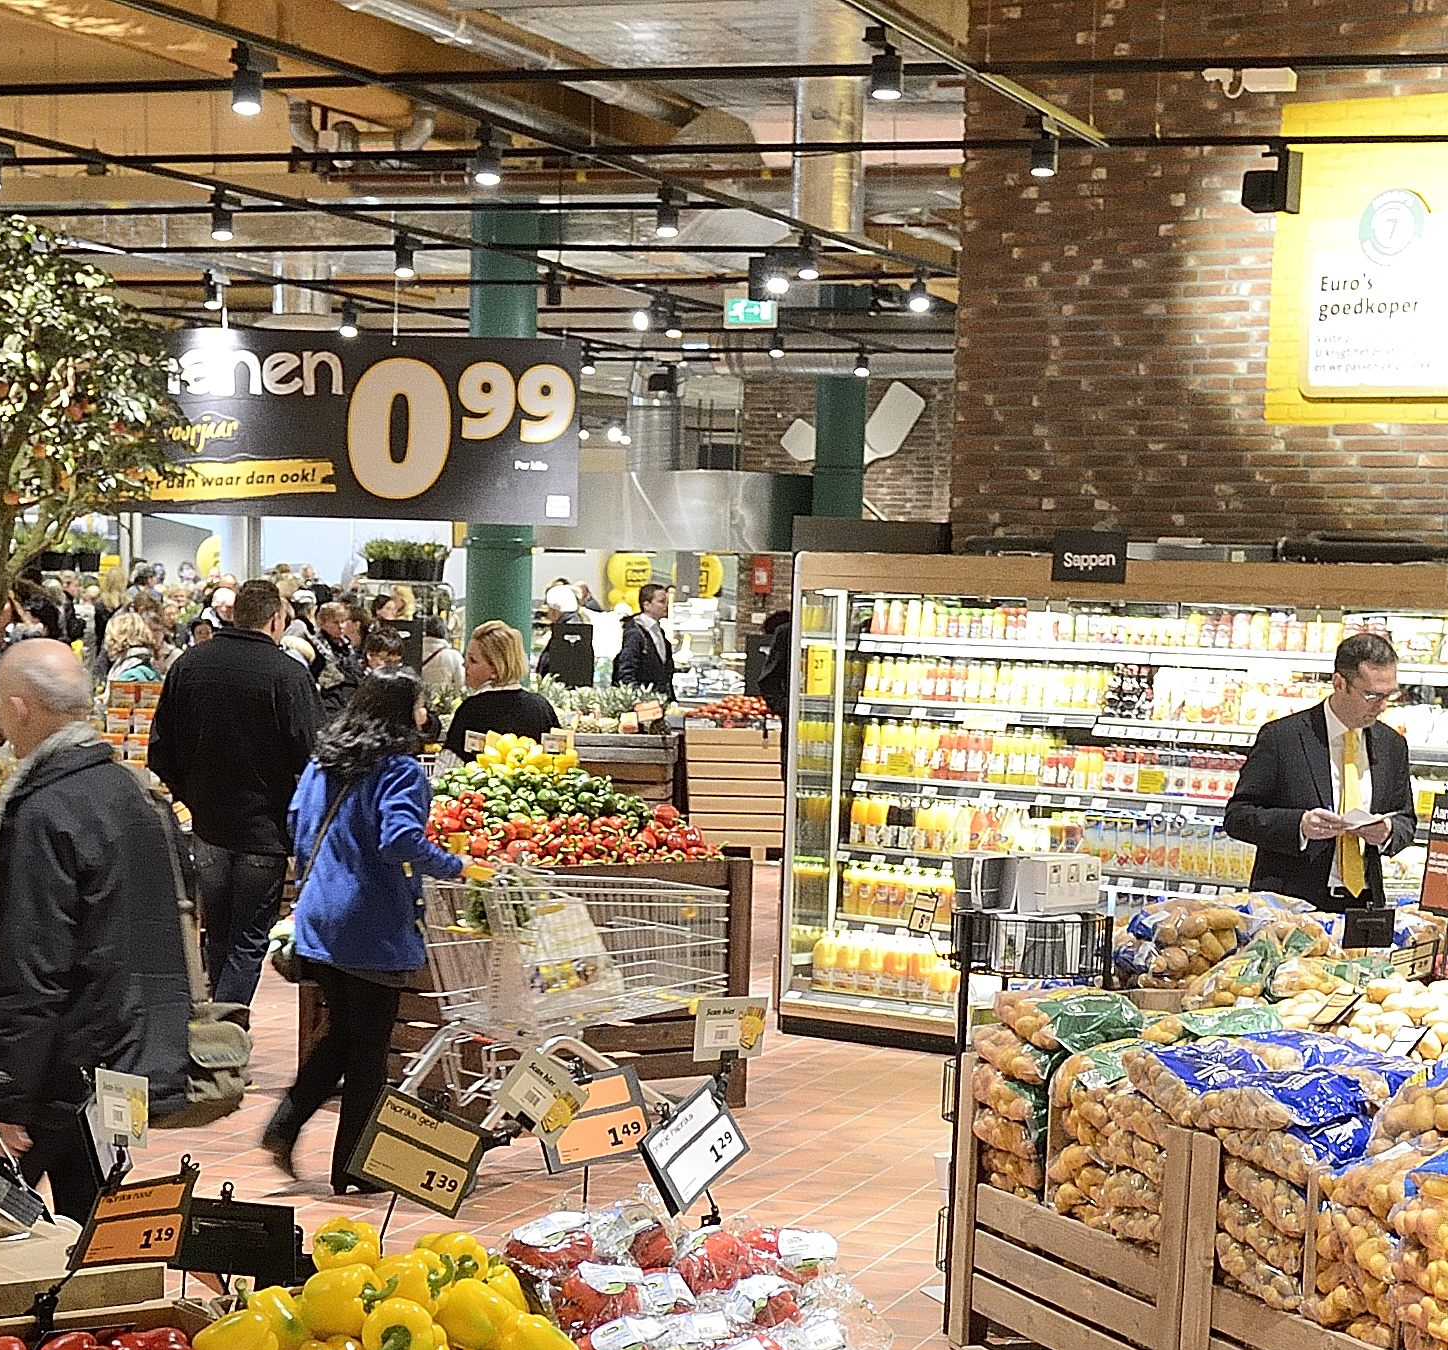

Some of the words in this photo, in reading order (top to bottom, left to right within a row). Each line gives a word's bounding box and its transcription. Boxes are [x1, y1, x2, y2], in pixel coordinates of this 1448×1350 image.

[1321, 273, 1373, 292] Euro's
[1319, 299, 1419, 322] goedkoper
[202, 474, 241, 487] waar
[246, 471, 275, 485] dan
[280, 469, 316, 483] ook!
[1063, 552, 1117, 570] Sappen
[529, 1061, 545, 1077] Scan
[417, 1116, 439, 1130] geel
